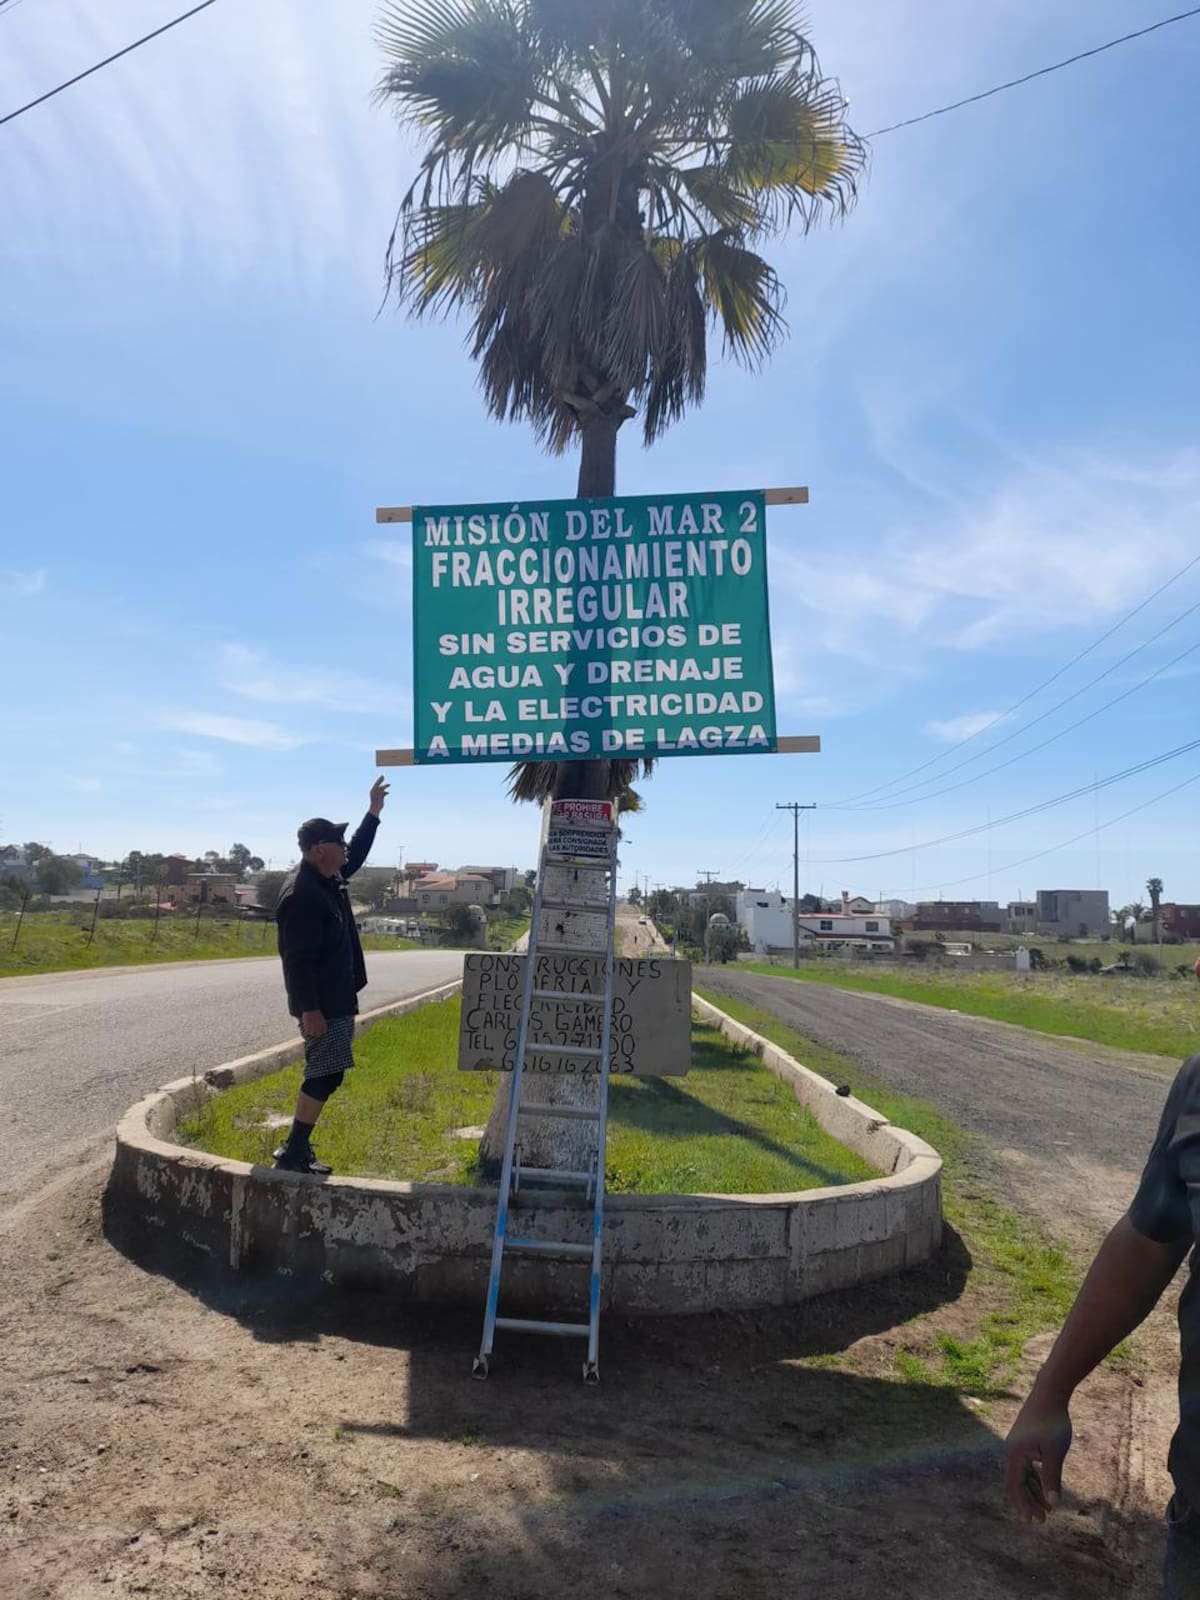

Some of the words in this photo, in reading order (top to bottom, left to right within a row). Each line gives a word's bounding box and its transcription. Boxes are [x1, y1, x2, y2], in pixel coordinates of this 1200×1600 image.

[424, 504, 549, 546] MISIÓN
[565, 508, 633, 541] DEL
[648, 503, 725, 536] MAR
[738, 501, 757, 533] 2
[432, 538, 752, 587] FRACCIONAMIENTO
[498, 582, 689, 626] IRREGULAR
[439, 632, 495, 656] SIN
[507, 625, 687, 654] SERVICIOS
[699, 623, 742, 646] DE
[448, 665, 543, 690] AGUA
[553, 663, 575, 685] Y
[587, 657, 743, 685] DRENAJE
[430, 701, 452, 723] Y
[464, 700, 507, 723] LA
[518, 690, 763, 721] ELECTRICIDAD
[426, 735, 450, 758] A
[461, 730, 591, 756] MEDIAS
[602, 728, 645, 752] DE
[656, 724, 769, 750] LAGZA
[466, 955, 661, 978] CONSRUCCIONES
[626, 979, 641, 995] Y
[466, 1008, 543, 1031] CARLS
